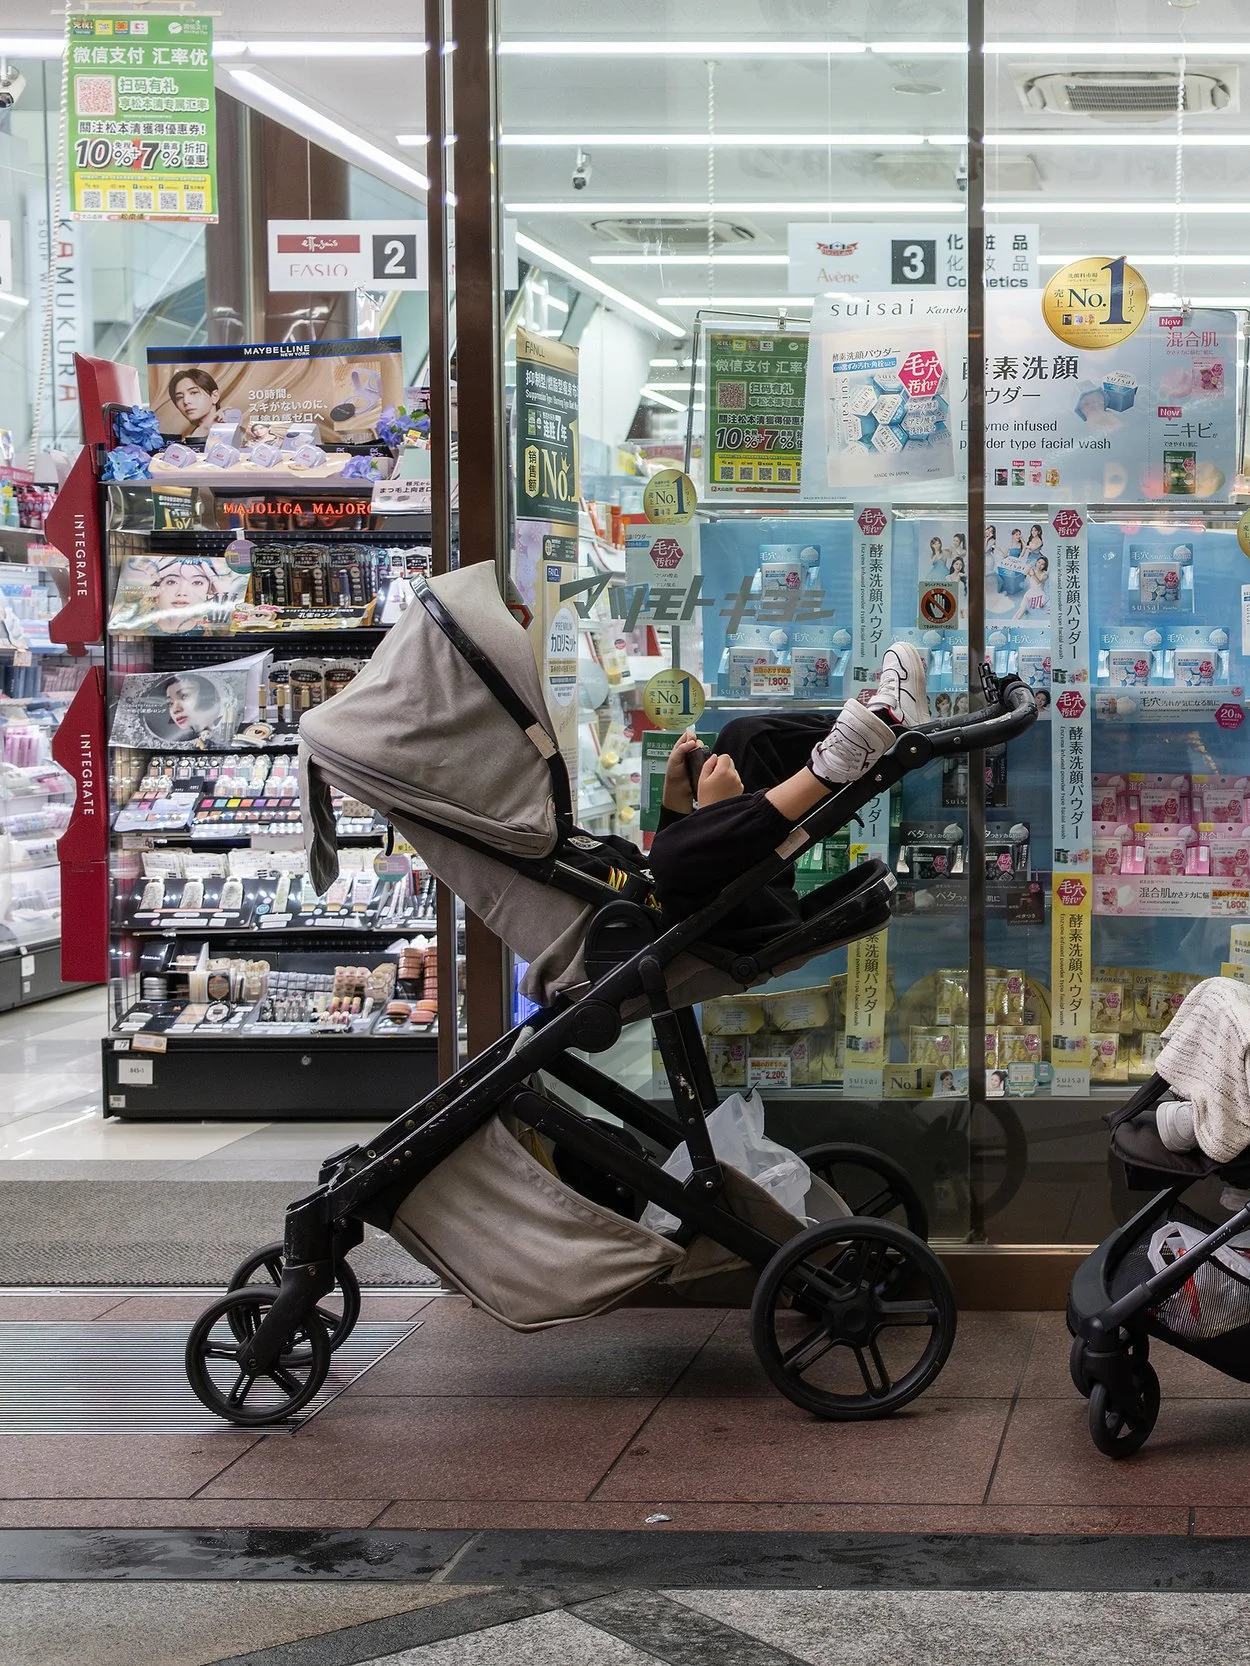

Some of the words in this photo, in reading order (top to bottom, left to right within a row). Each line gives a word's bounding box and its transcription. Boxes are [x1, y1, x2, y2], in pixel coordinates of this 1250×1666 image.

[74, 47, 144, 64] 微信支付
[152, 48, 208, 65] 汇率优
[118, 77, 178, 94] 扫码有礼
[184, 142, 206, 154] 折扣
[184, 155, 206, 165] 優惠
[384, 240, 406, 274] 2
[902, 244, 925, 280] 3
[290, 264, 348, 277] FASIO
[817, 268, 860, 283] Avène
[1054, 289, 1063, 308] 売上
[56, 219, 77, 401] KAMUKURA
[830, 299, 914, 316] suisai
[1161, 318, 1180, 326] Now
[1166, 332, 1219, 348] 混合肌
[244, 345, 310, 355] MAYBELLINE
[832, 348, 900, 362] 酵素洗顔パウダー
[716, 359, 770, 373] 微信支付
[776, 361, 807, 374] 汇率
[904, 354, 940, 379] 毛穴
[248, 389, 292, 400] 30時間。
[749, 382, 794, 395] 扫码有礼
[249, 400, 328, 412] スキがないのに、
[841, 377, 849, 423] suisai
[961, 420, 1009, 432] Eyme
[1014, 420, 1057, 431] infused
[960, 438, 1005, 450] pder
[1010, 440, 1036, 450] type
[1041, 438, 1074, 449] facial
[1079, 438, 1111, 449] wash
[223, 503, 303, 515] MAJOLICA
[312, 502, 372, 515] MAJORC
[861, 510, 885, 527] 毛穴
[1055, 512, 1081, 527] 毛穴
[74, 514, 87, 596] INTEGRATE
[654, 541, 680, 558] 毛穴
[760, 552, 777, 561] 毛穴
[1132, 551, 1149, 560] 毛穴
[869, 543, 883, 658] 酵素洗顔パウダー
[1030, 595, 1043, 609] 肌
[1066, 546, 1082, 659] 酵素洗顔パウダー
[728, 633, 744, 641] 毛穴
[793, 633, 809, 642] 毛穴
[948, 636, 963, 644] 毛穴
[1012, 635, 1029, 643] 毛穴
[1101, 634, 1119, 643] 毛穴
[1167, 634, 1184, 643] 毛穴
[1060, 692, 1083, 709] 毛穴
[1220, 709, 1242, 719] 20th
[80, 734, 94, 816] INTEGRATE
[1069, 726, 1084, 839] 酵素洗顔パウダー
[1059, 881, 1084, 896] 毛穴
[1068, 914, 1083, 1026] 酵素洗顔パウダー
[1056, 1076, 1085, 1084] suisai
